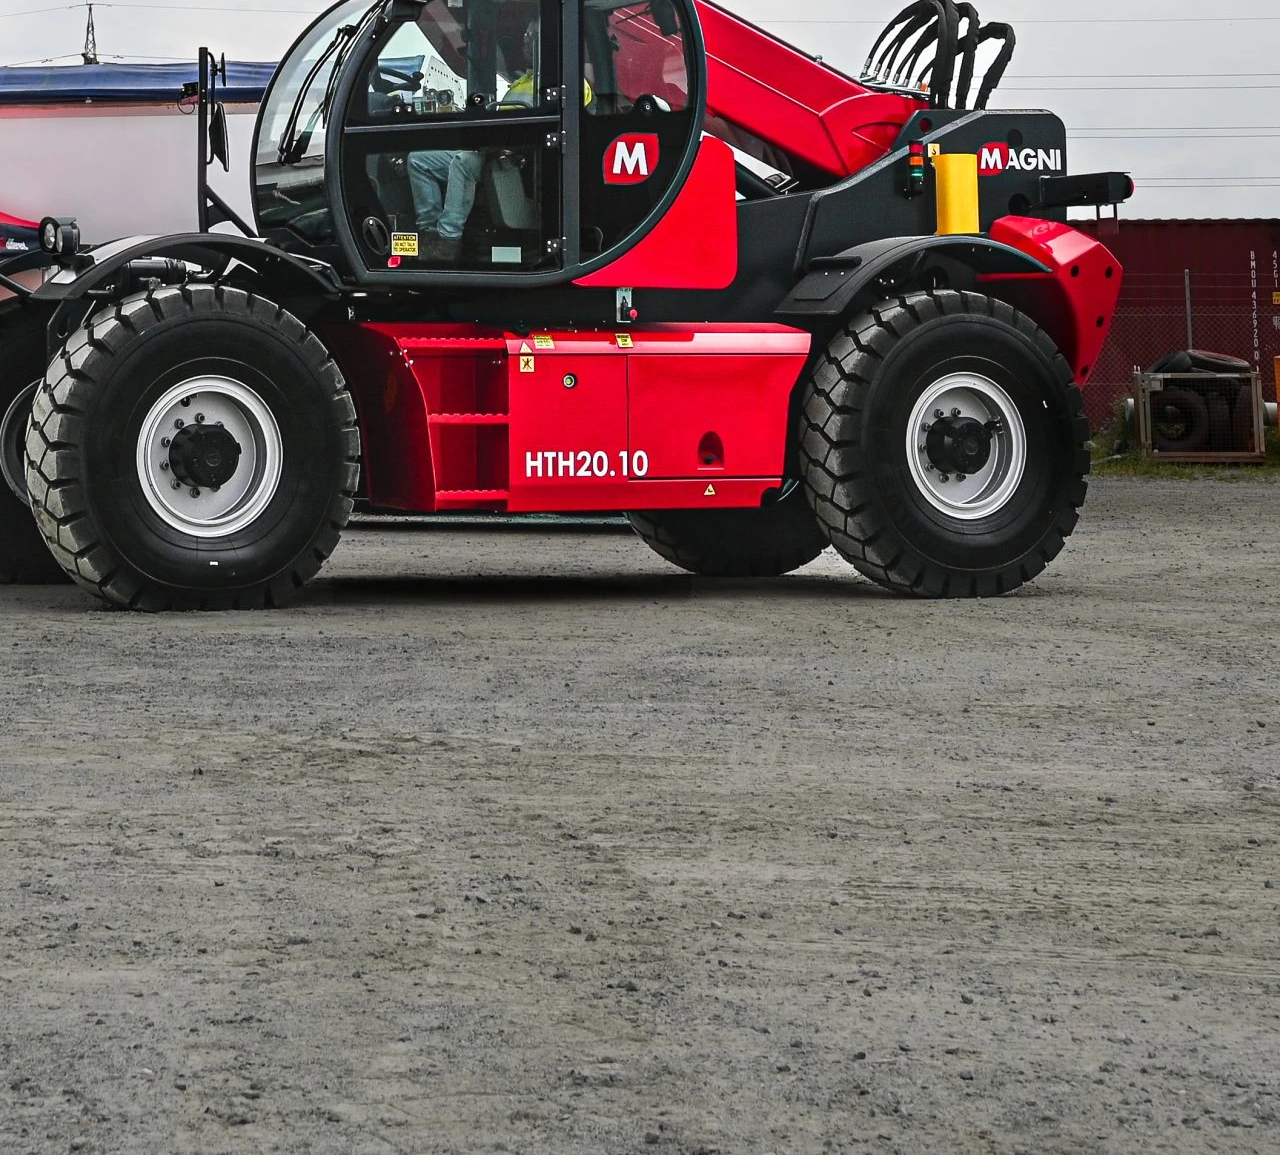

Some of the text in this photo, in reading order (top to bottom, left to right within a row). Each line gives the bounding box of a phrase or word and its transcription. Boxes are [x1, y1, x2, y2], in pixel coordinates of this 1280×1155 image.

[612, 141, 648, 176] M
[980, 148, 1062, 170] MAGNI
[1251, 291, 1259, 347] 436920
[525, 450, 649, 477] HTH20.10
